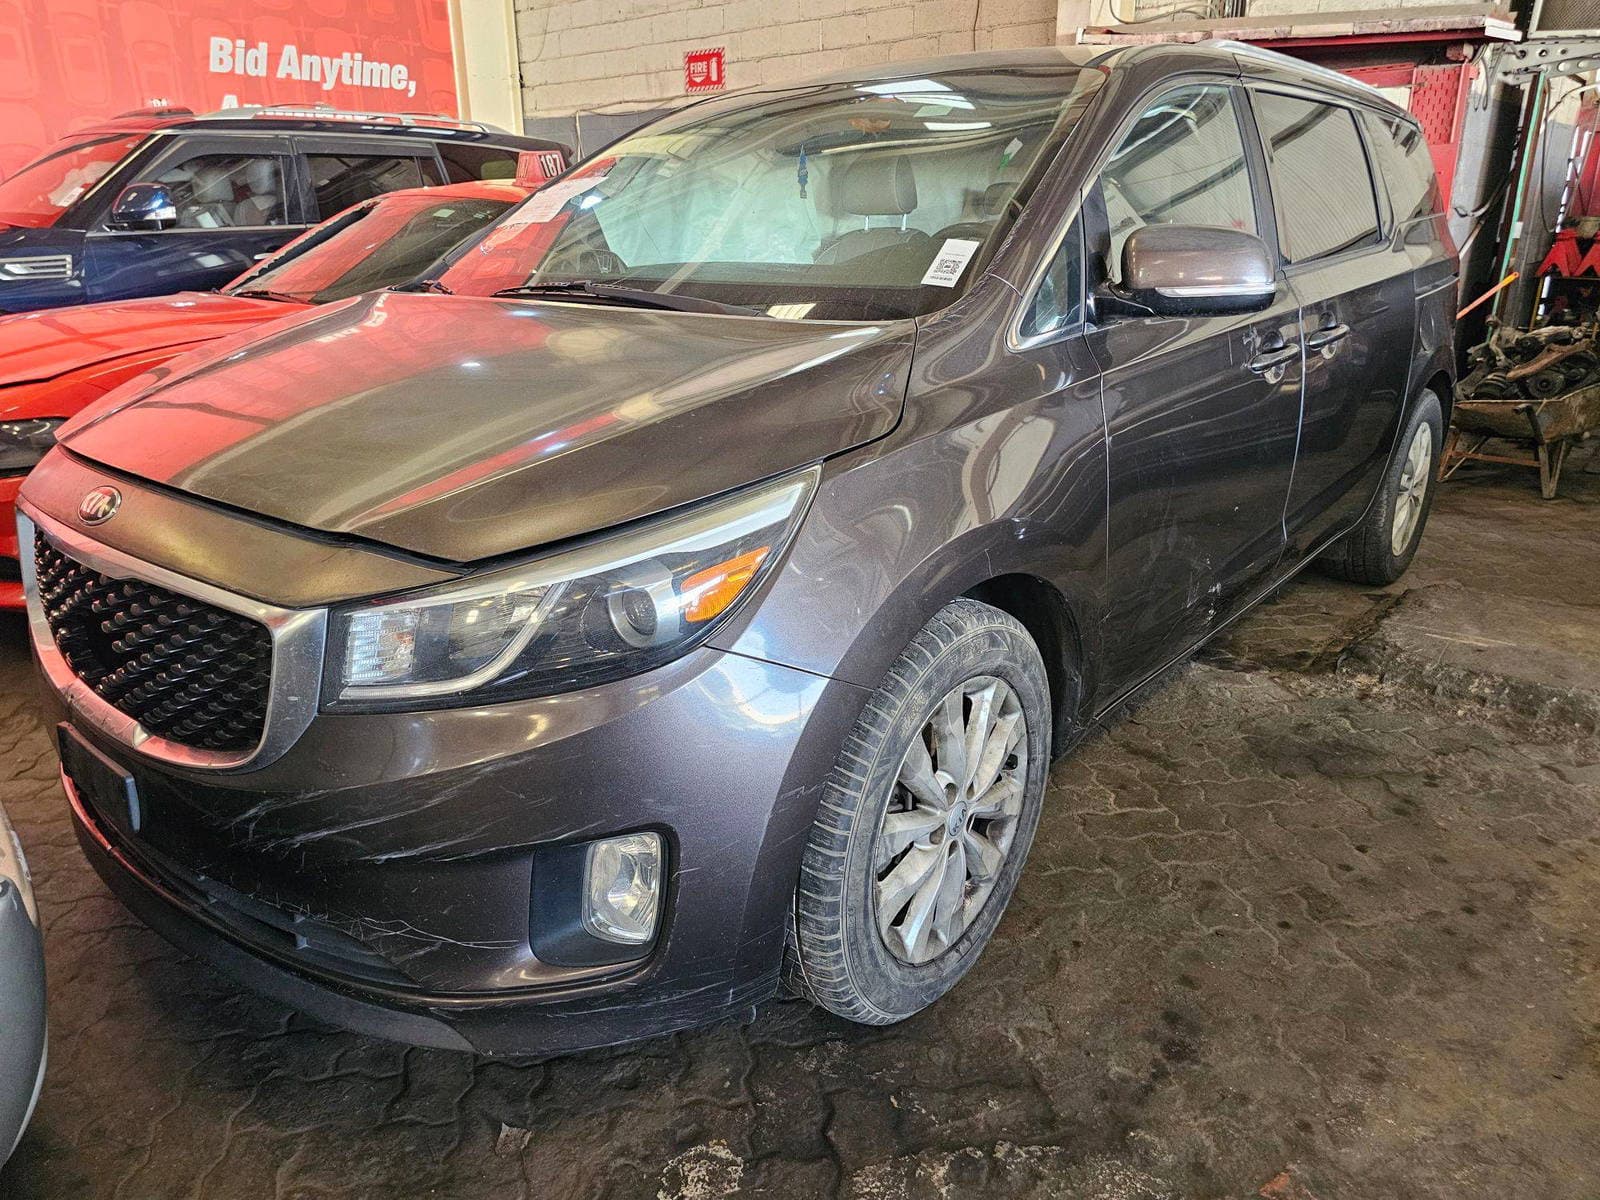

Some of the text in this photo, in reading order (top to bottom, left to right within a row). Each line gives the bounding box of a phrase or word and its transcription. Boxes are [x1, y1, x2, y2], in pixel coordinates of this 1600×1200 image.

[209, 36, 417, 98] Bid Anytime,
[690, 61, 708, 74] FIRE
[539, 153, 563, 178] 187
